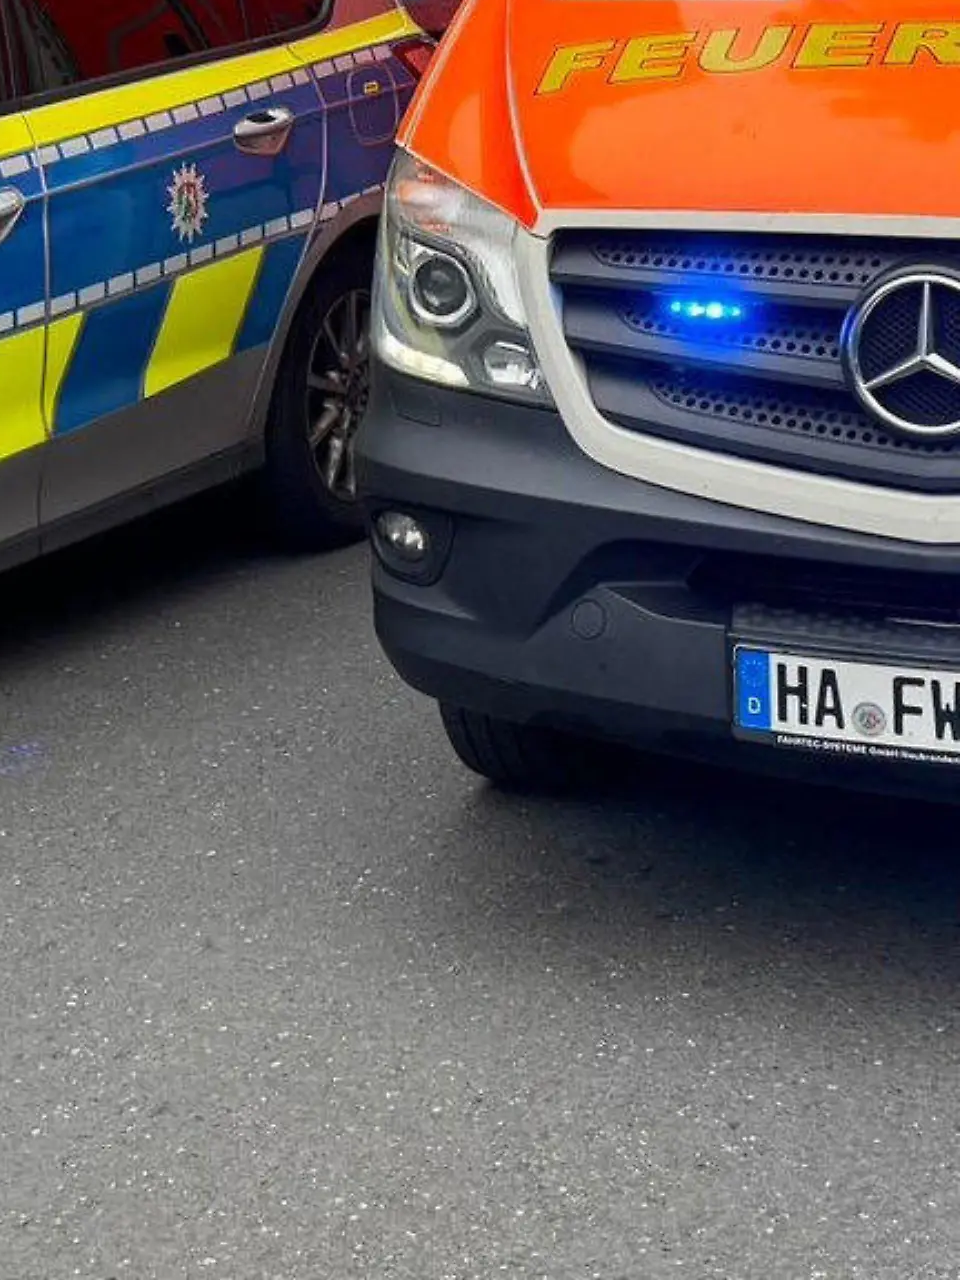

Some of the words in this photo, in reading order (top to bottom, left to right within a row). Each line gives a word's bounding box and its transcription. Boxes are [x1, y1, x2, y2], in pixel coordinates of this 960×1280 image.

[533, 21, 960, 96] FEUER
[748, 696, 761, 715] D
[776, 662, 845, 730] HA
